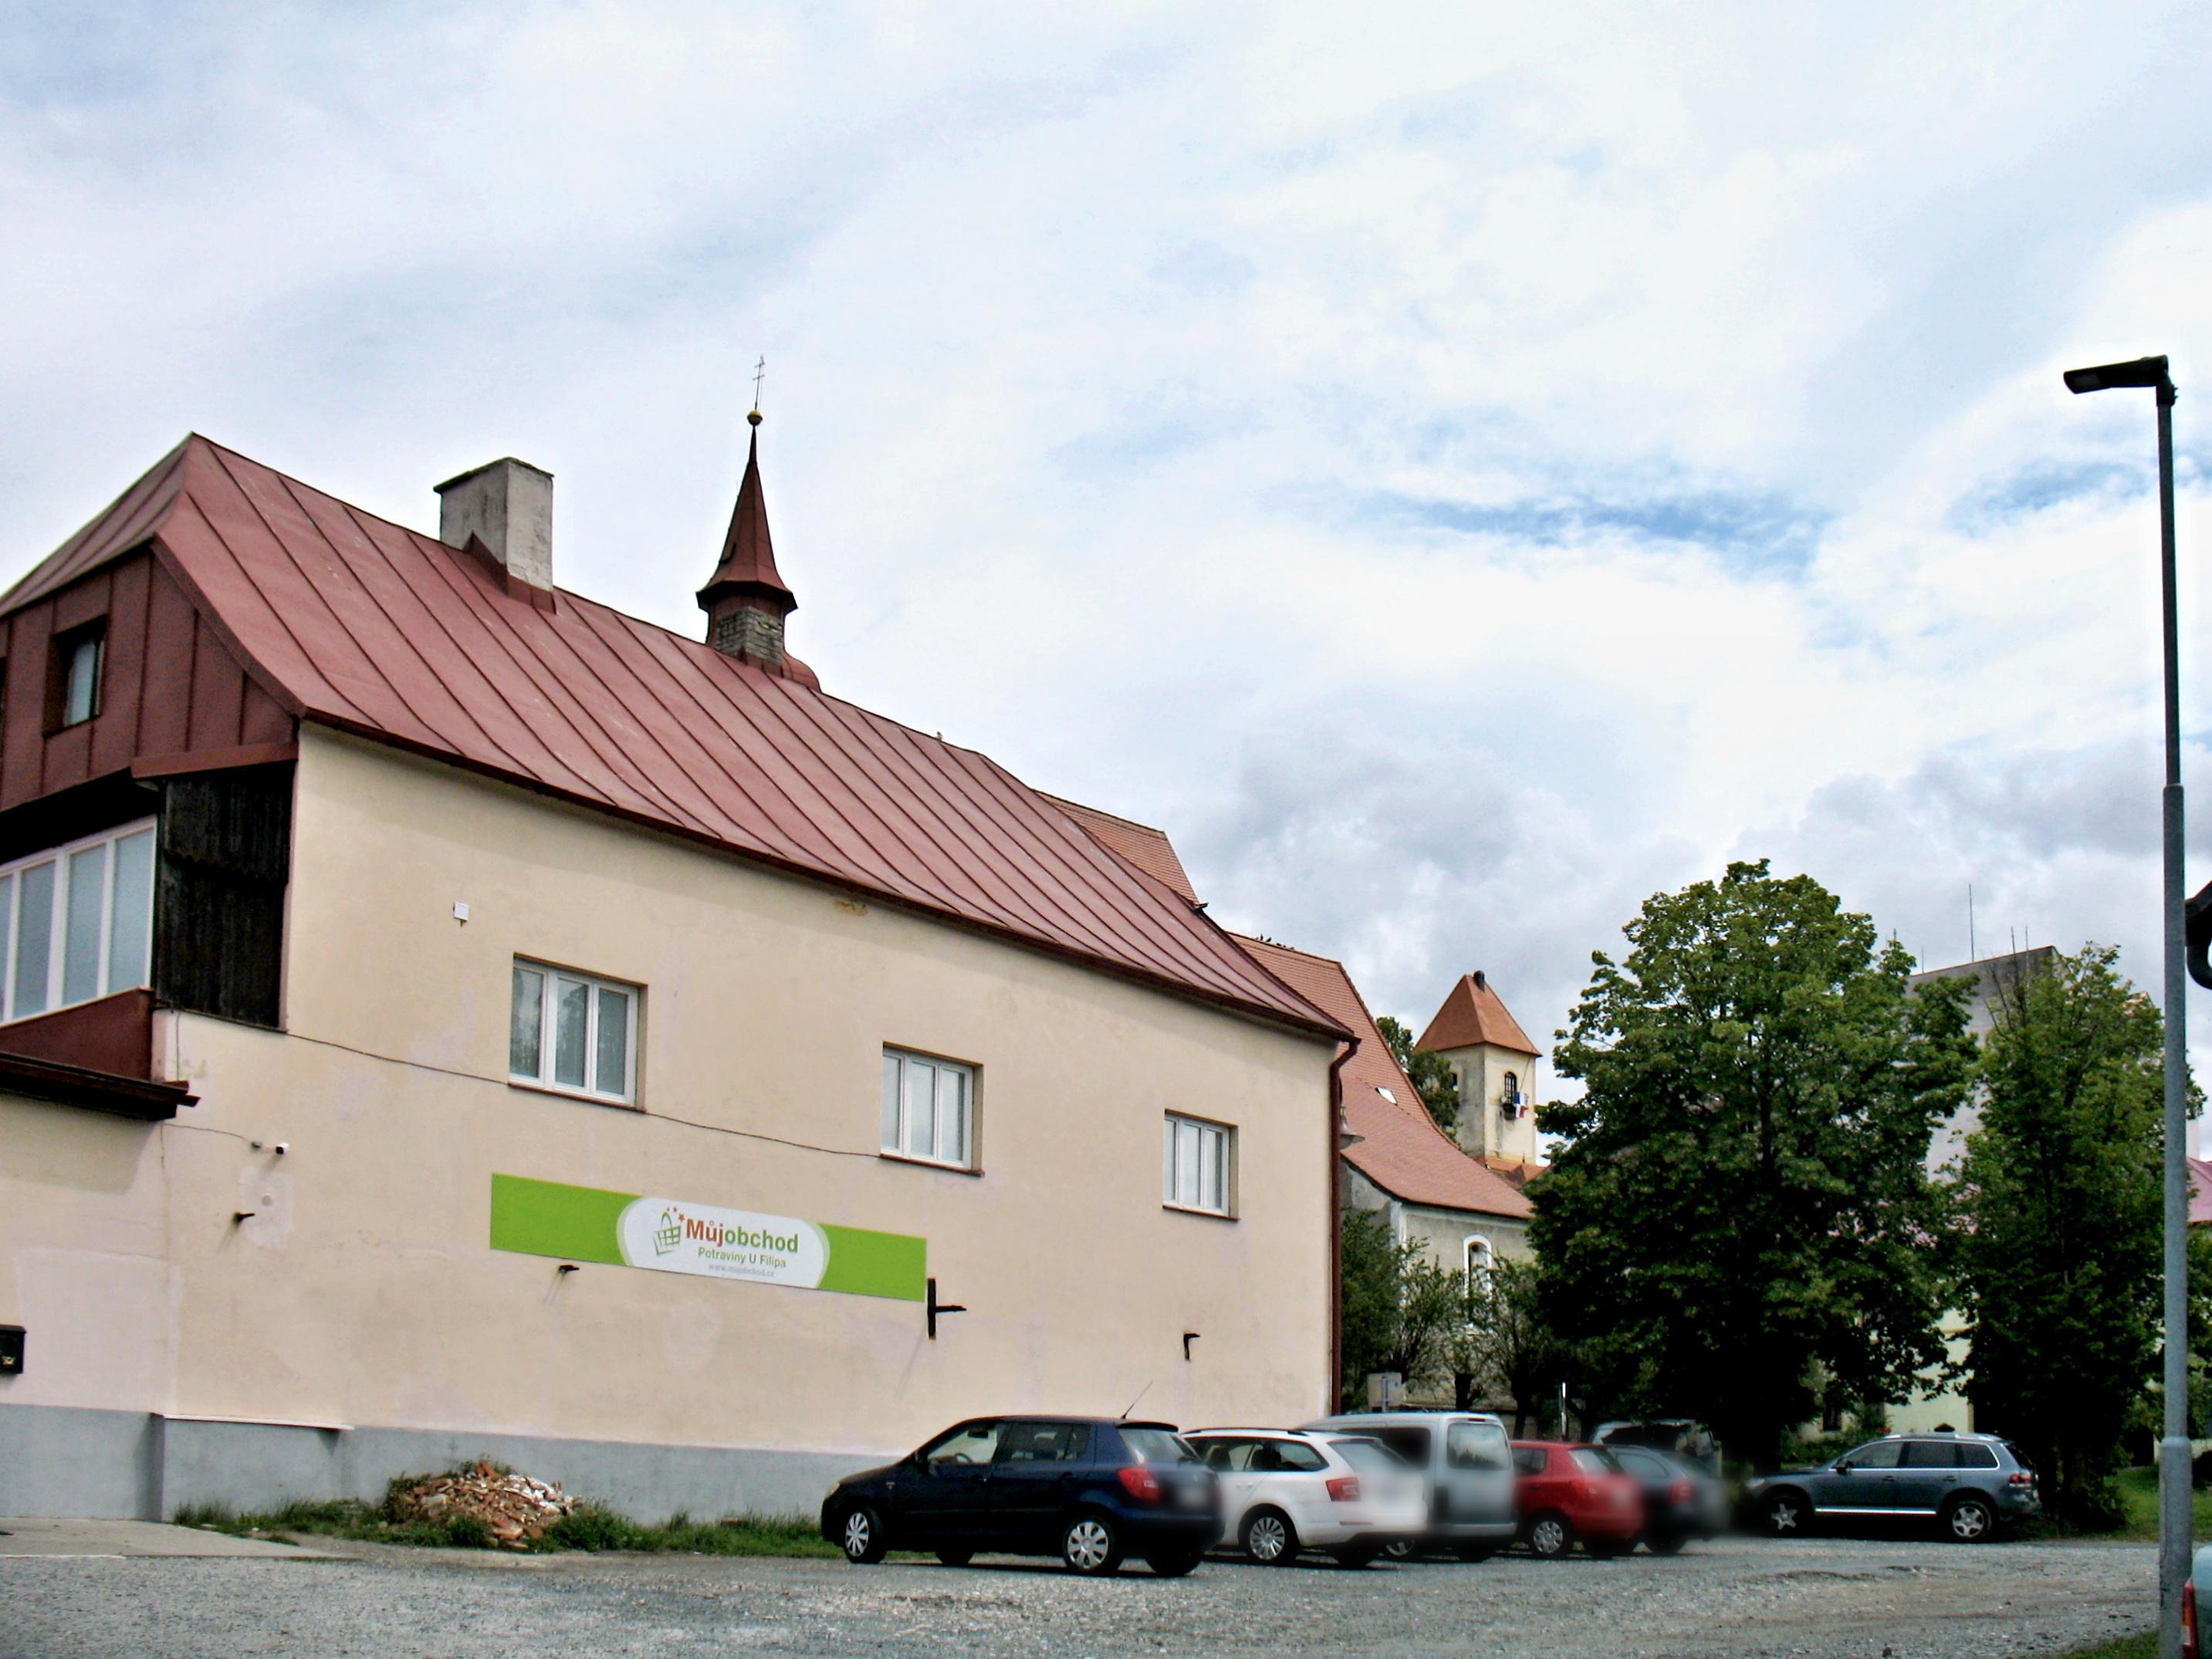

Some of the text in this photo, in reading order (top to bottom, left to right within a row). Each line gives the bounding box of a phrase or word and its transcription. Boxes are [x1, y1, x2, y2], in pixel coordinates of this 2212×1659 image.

[698, 1247, 786, 1269] Potraviny U Filipa
